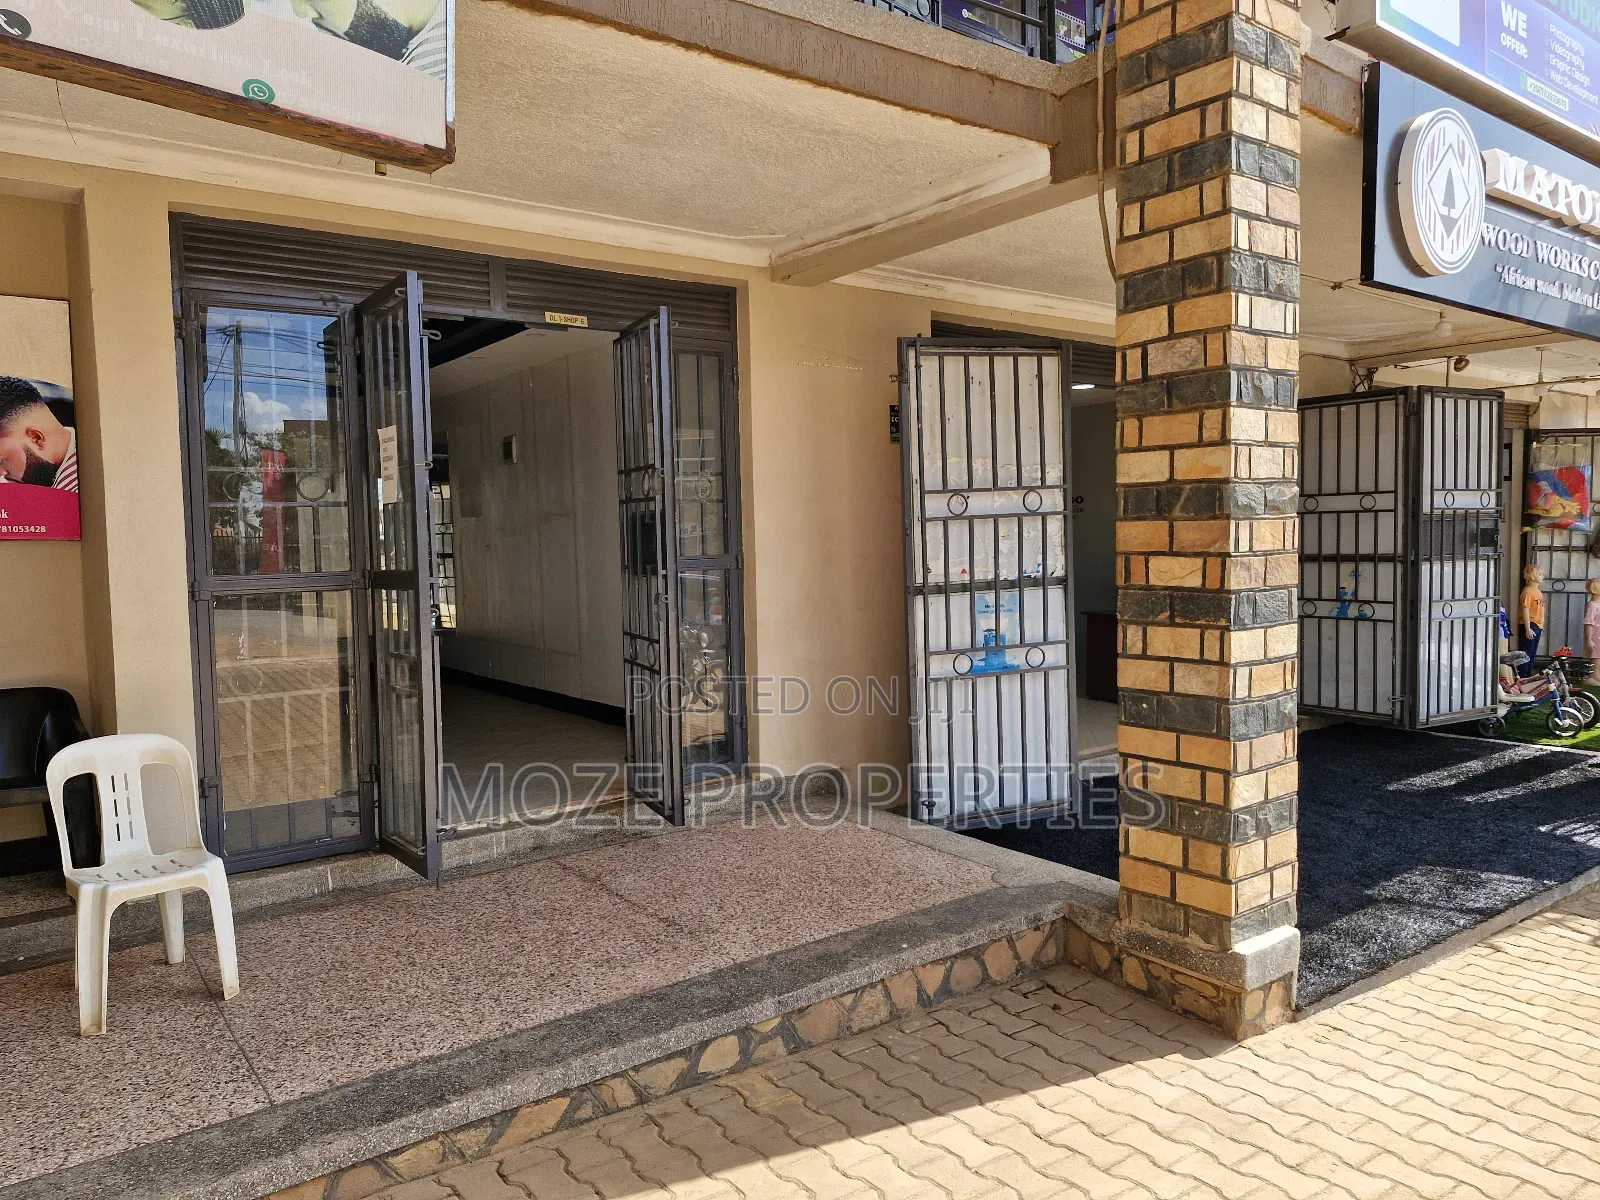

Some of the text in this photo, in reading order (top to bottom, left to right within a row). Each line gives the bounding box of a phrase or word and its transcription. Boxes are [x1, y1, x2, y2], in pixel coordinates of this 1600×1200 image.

[1501, 0, 1527, 38] WE
[1549, 24, 1585, 57] Photography
[1549, 39, 1585, 71] Videography
[1549, 54, 1591, 87] Graphic Design
[1549, 69, 1599, 105] Web Development
[1480, 221, 1534, 258] WOOD
[1562, 283, 1593, 309] Modern
[0, 525, 46, 533] 81053428
